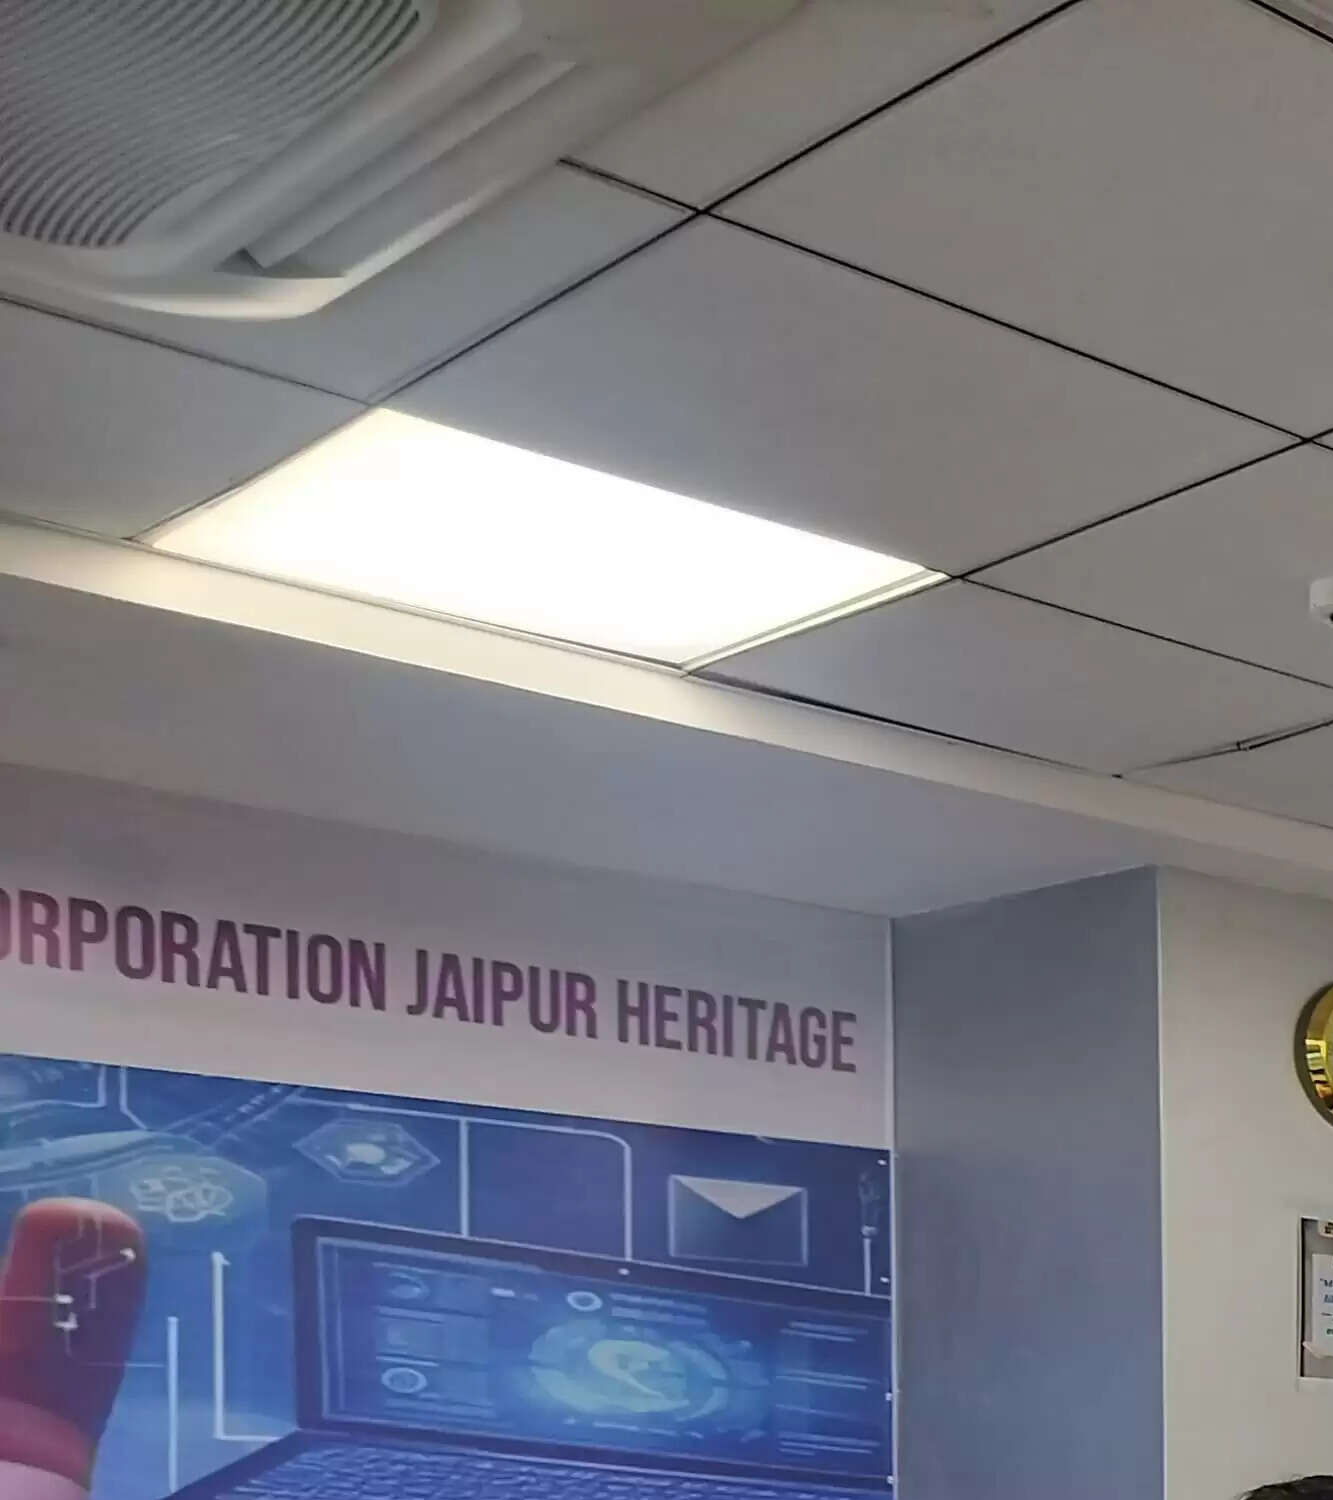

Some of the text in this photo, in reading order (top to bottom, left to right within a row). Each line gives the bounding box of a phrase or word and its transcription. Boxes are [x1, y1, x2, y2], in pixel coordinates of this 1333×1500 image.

[0, 888, 858, 1075] RPORATION JAIPUR HERITAGE
